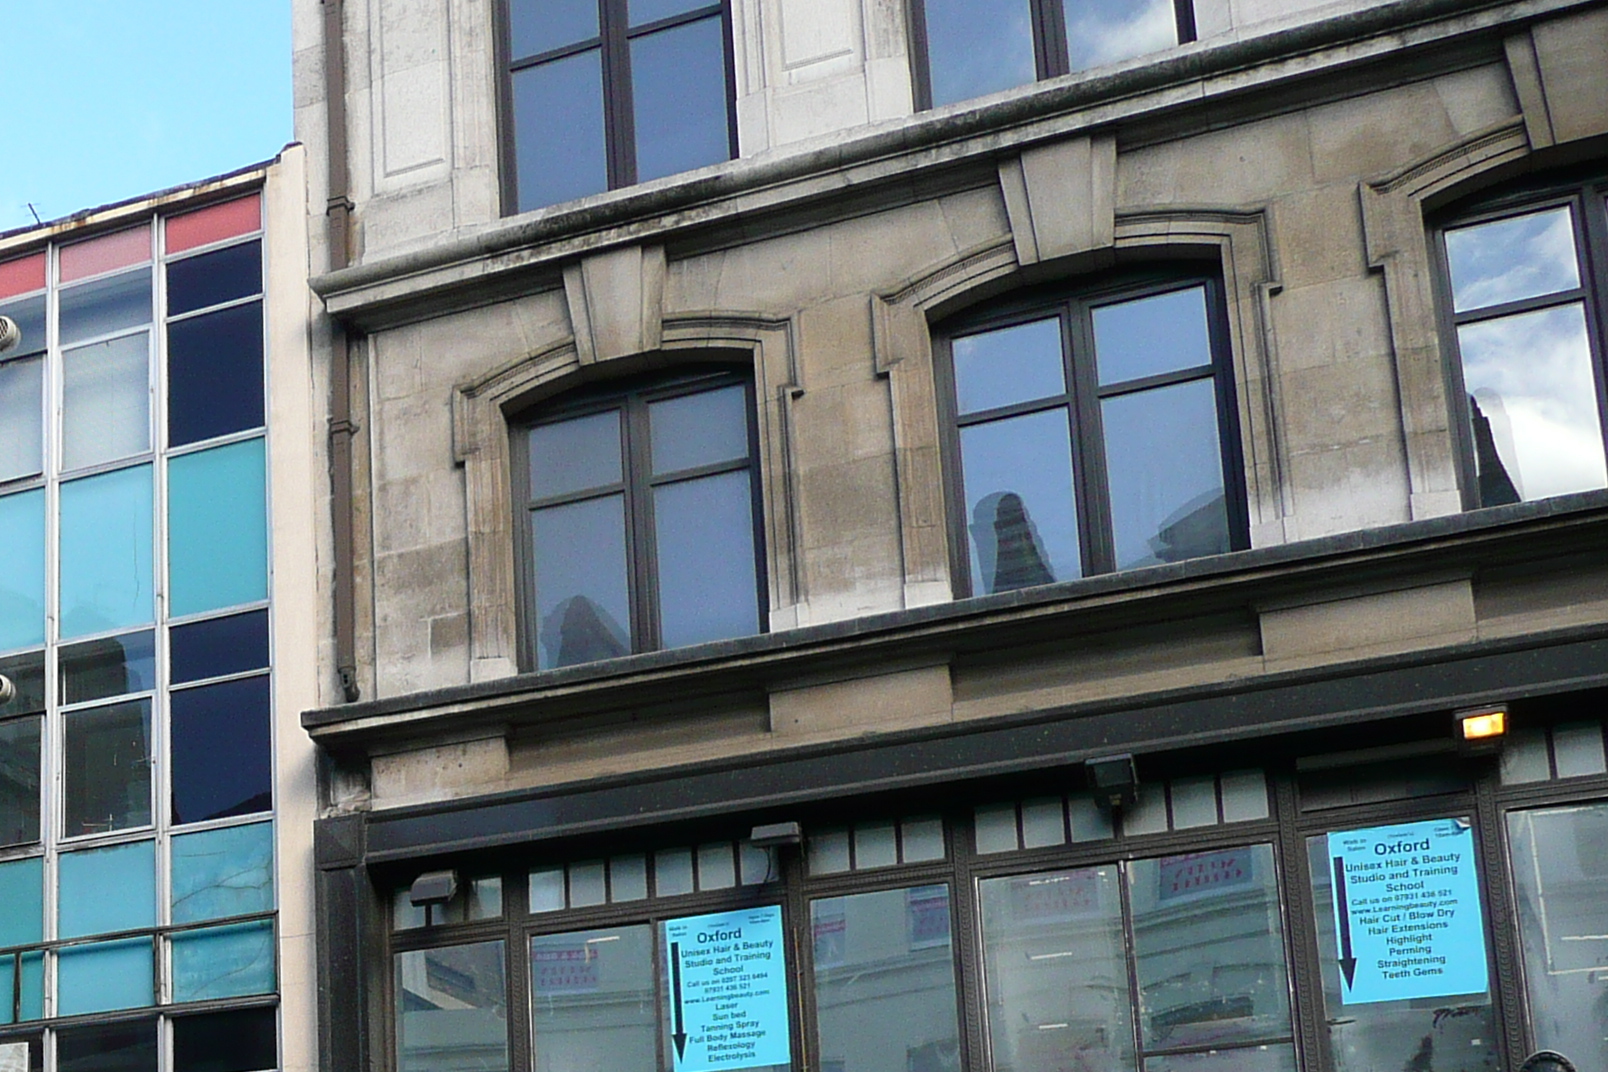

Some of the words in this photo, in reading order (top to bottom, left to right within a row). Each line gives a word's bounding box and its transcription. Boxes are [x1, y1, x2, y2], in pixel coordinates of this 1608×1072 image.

[1374, 838, 1430, 855] Oxford
[1345, 862, 1382, 872] Unisex
[1385, 858, 1407, 868] Hair
[1411, 856, 1419, 865] &
[1422, 853, 1460, 863] Beauty
[1350, 873, 1386, 884] Studio
[1388, 869, 1409, 880] and
[1413, 866, 1458, 878] Training
[1386, 881, 1424, 892] School
[1351, 898, 1368, 906] Call
[1359, 916, 1379, 925] Hair
[1382, 914, 1400, 923] Cut
[1408, 911, 1434, 920] Blow
[1437, 909, 1455, 918] Dry
[1368, 926, 1388, 936] Hair
[1391, 921, 1448, 933] Extensions
[697, 928, 742, 943] Oxford
[1386, 933, 1433, 946] Highlight
[681, 948, 710, 958] Unisex
[713, 945, 731, 954] Hair
[733, 943, 740, 951] &
[742, 939, 773, 950] Beauty
[1389, 945, 1432, 956] Perming
[685, 958, 713, 968] Studio
[716, 955, 732, 964] and
[735, 951, 771, 962] Training
[1377, 956, 1446, 969] Straightening
[713, 965, 744, 975] School
[1382, 969, 1410, 980] Teeth
[1413, 967, 1443, 977] Gems
[715, 1002, 738, 1011] Laser
[712, 1013, 729, 1021] Sun
[731, 1010, 746, 1019] bed
[701, 1022, 734, 1033] Tanning
[735, 1020, 759, 1029] Spray
[689, 1036, 704, 1044] Full
[706, 1033, 727, 1043] Body
[730, 1030, 766, 1039] Massage
[708, 1051, 756, 1062] Electrolysis
